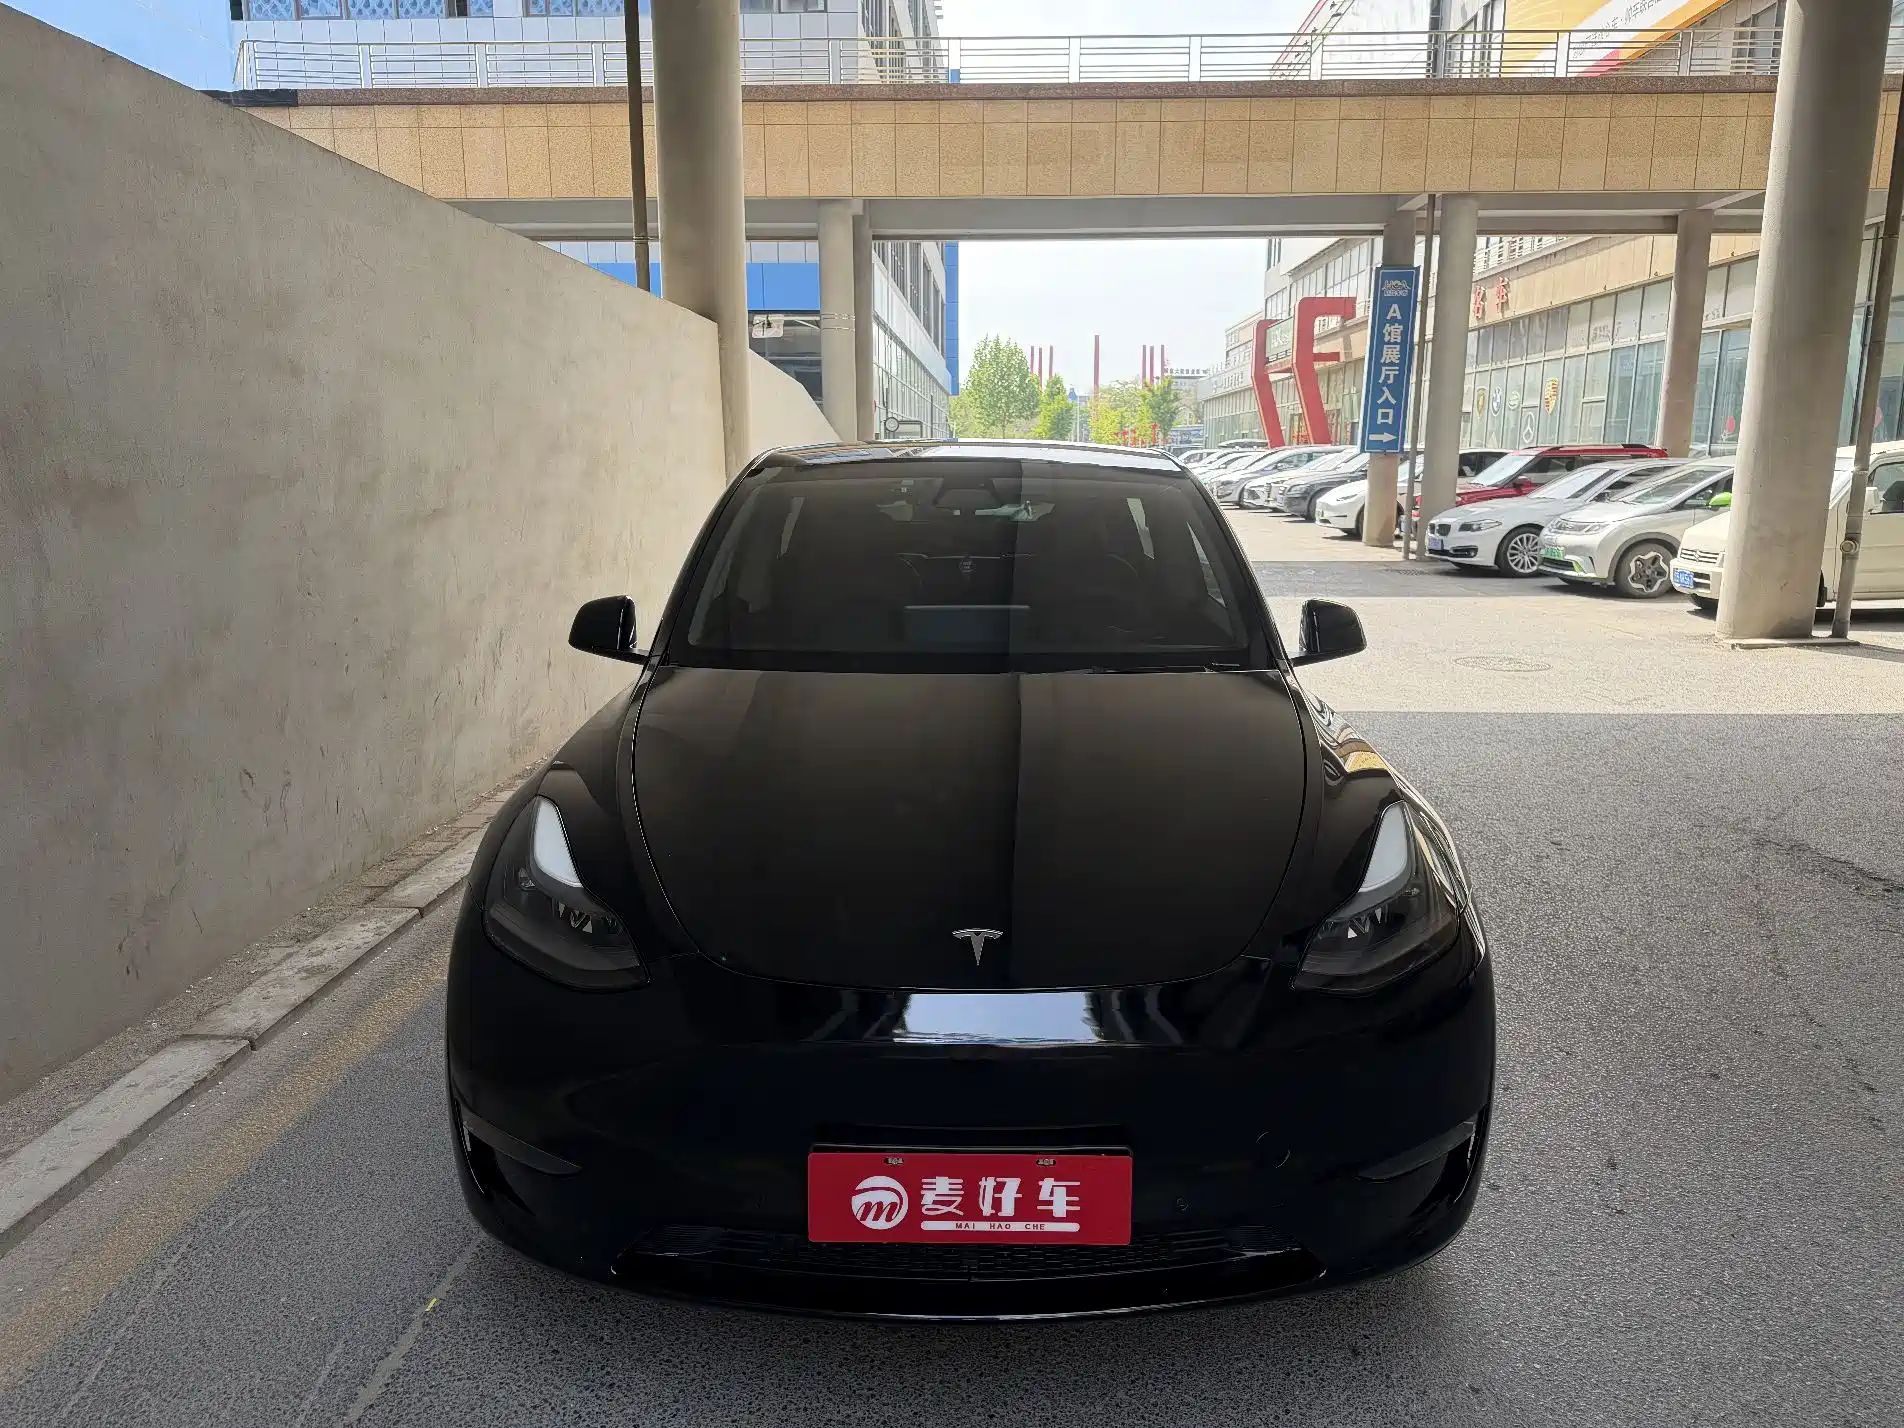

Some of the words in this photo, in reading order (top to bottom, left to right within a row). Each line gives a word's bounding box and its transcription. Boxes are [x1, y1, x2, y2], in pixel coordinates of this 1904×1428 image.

[1376, 303, 1404, 425] A馆展厅入口
[920, 1176, 1081, 1218] 麦好车
[955, 1222, 976, 1230] MAI
[989, 1222, 1011, 1230] HAO
[1024, 1223, 1045, 1231] CHE
